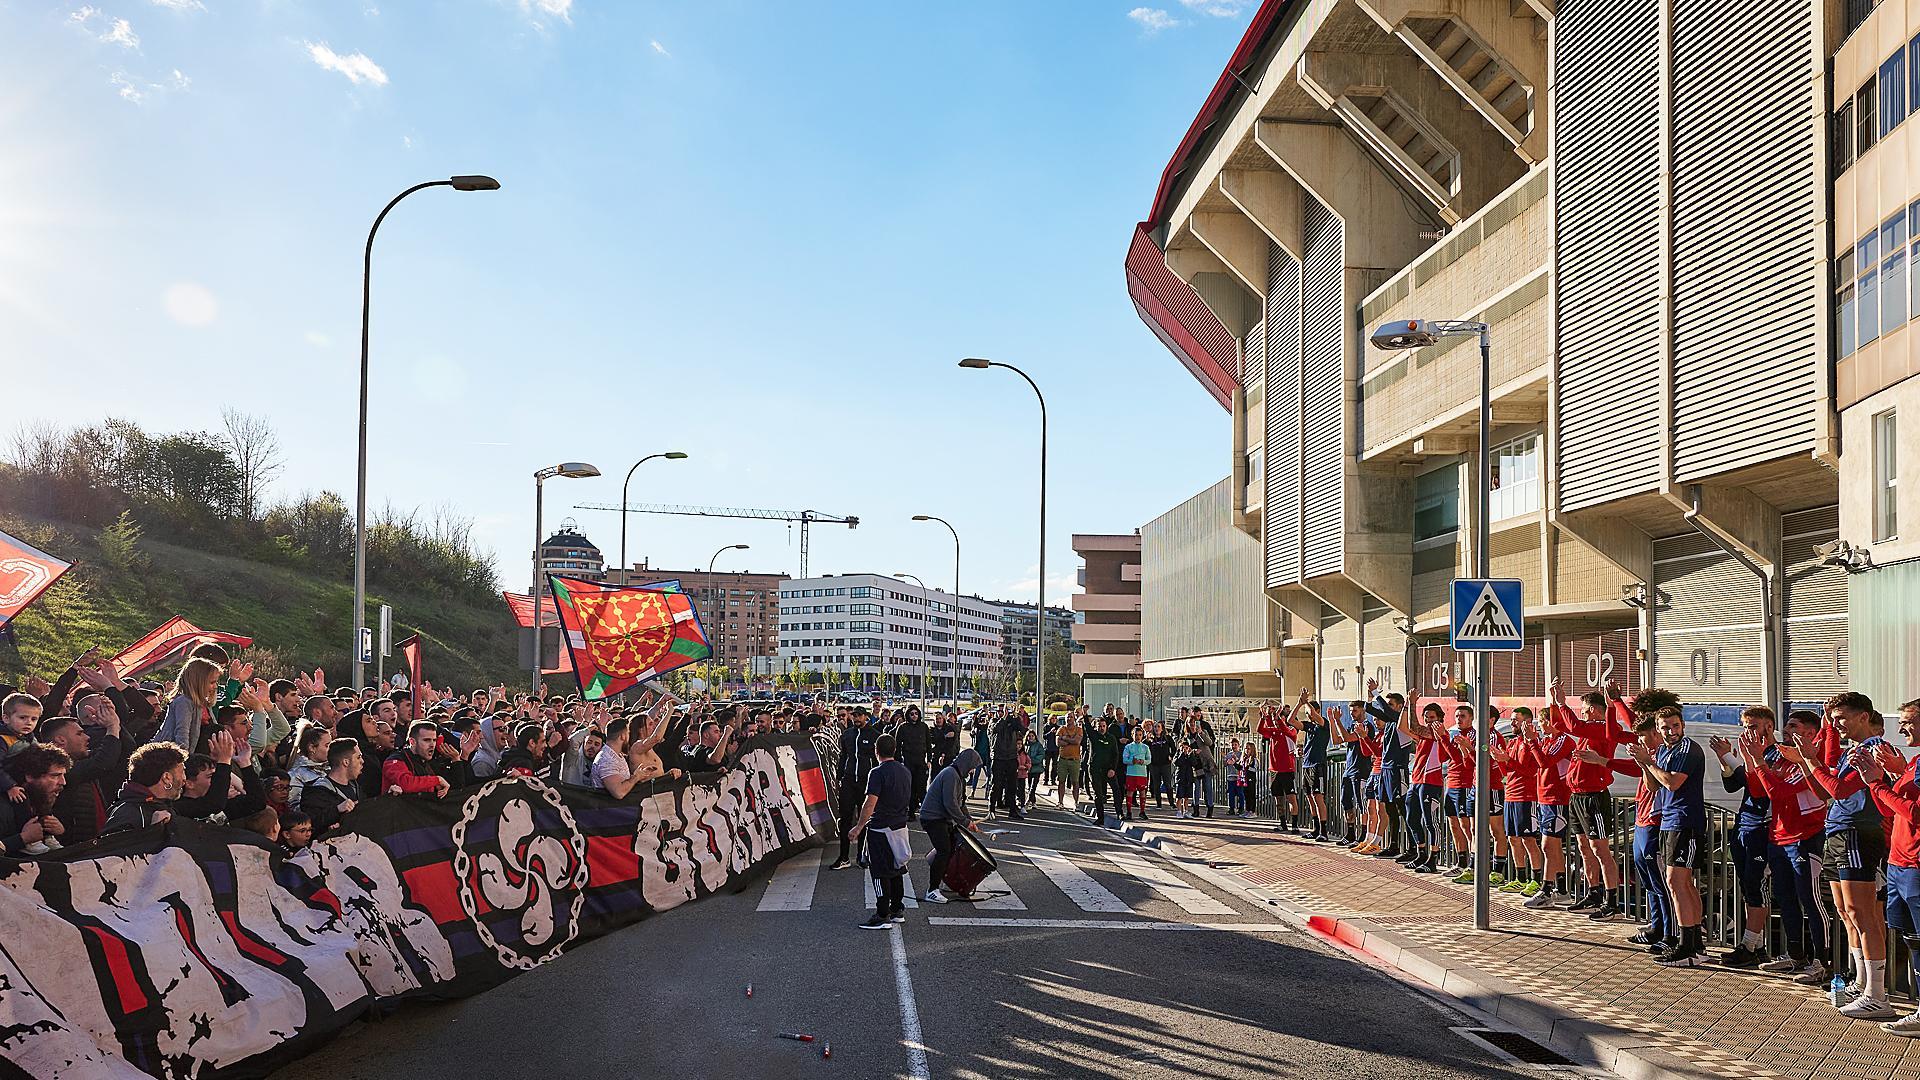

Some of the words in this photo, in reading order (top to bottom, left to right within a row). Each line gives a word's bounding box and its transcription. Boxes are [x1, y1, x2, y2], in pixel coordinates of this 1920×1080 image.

[1332, 668, 1345, 691] 05
[1376, 665, 1391, 691] 04
[1432, 662, 1449, 690] 03
[1586, 652, 1614, 688] 02
[1690, 647, 1720, 687] 01
